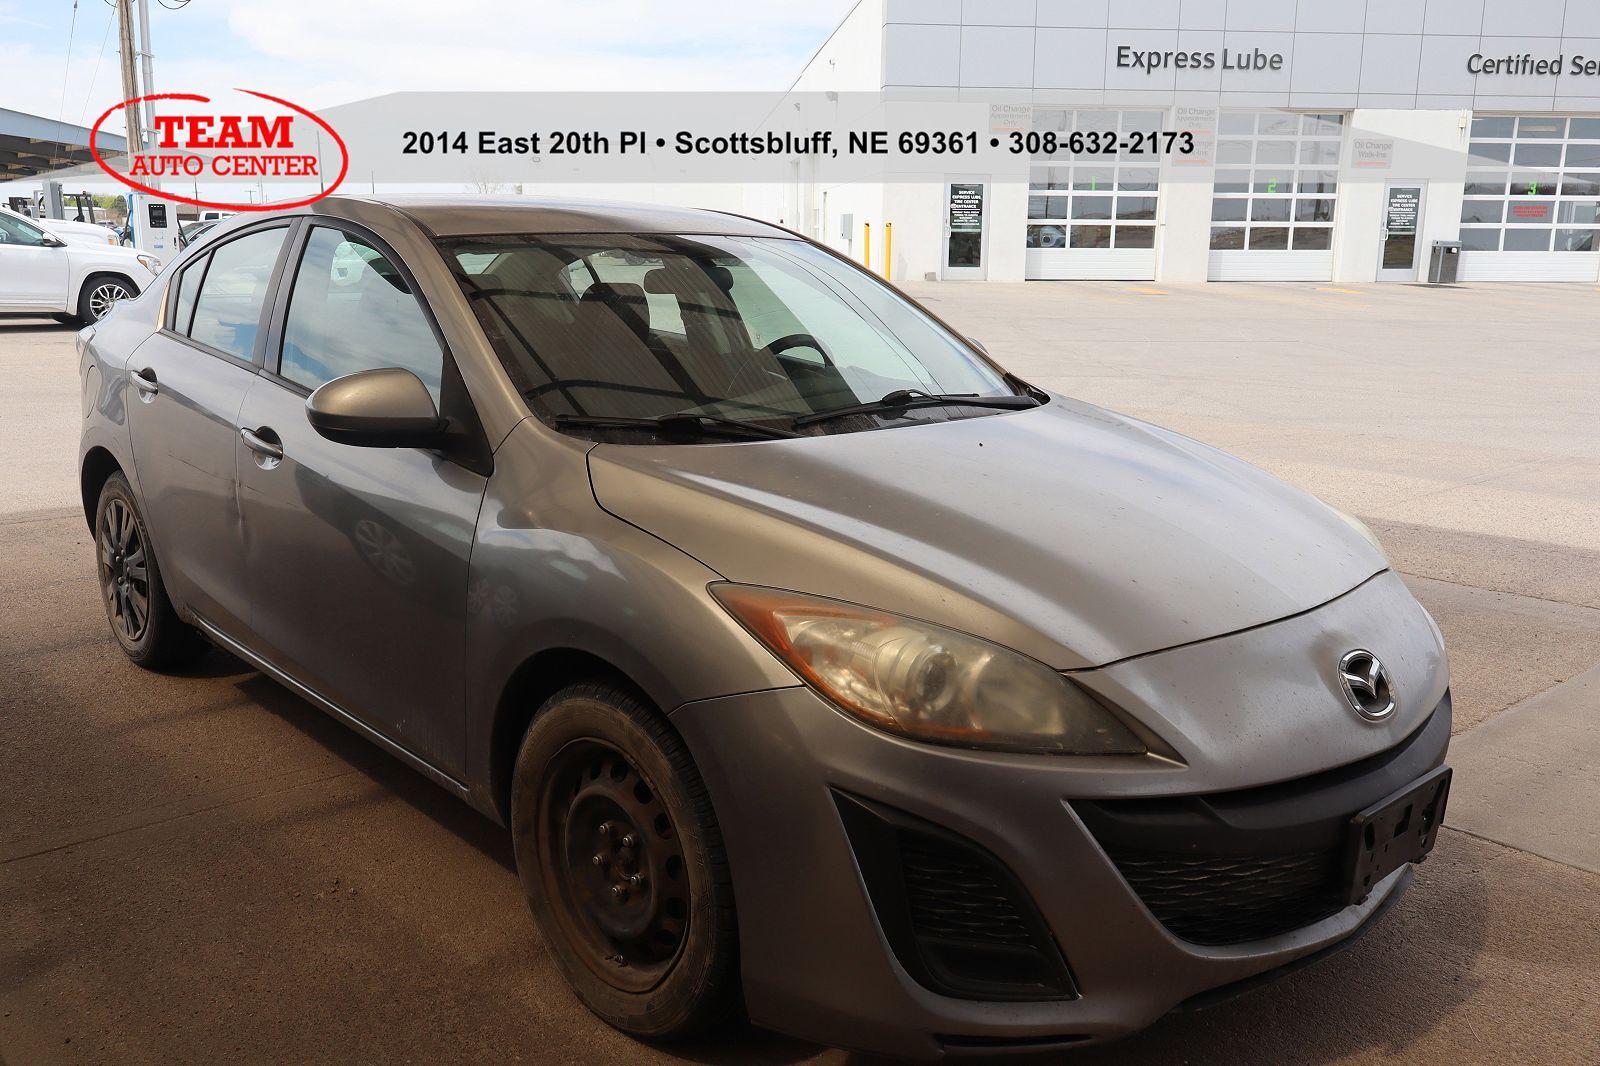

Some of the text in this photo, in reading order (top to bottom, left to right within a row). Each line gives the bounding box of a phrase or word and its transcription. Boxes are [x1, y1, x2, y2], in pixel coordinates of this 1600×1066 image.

[1116, 45, 1283, 75] Express Lube
[1467, 53, 1563, 75] Certified
[1267, 178, 1277, 193] 2
[1527, 181, 1538, 196] 3
